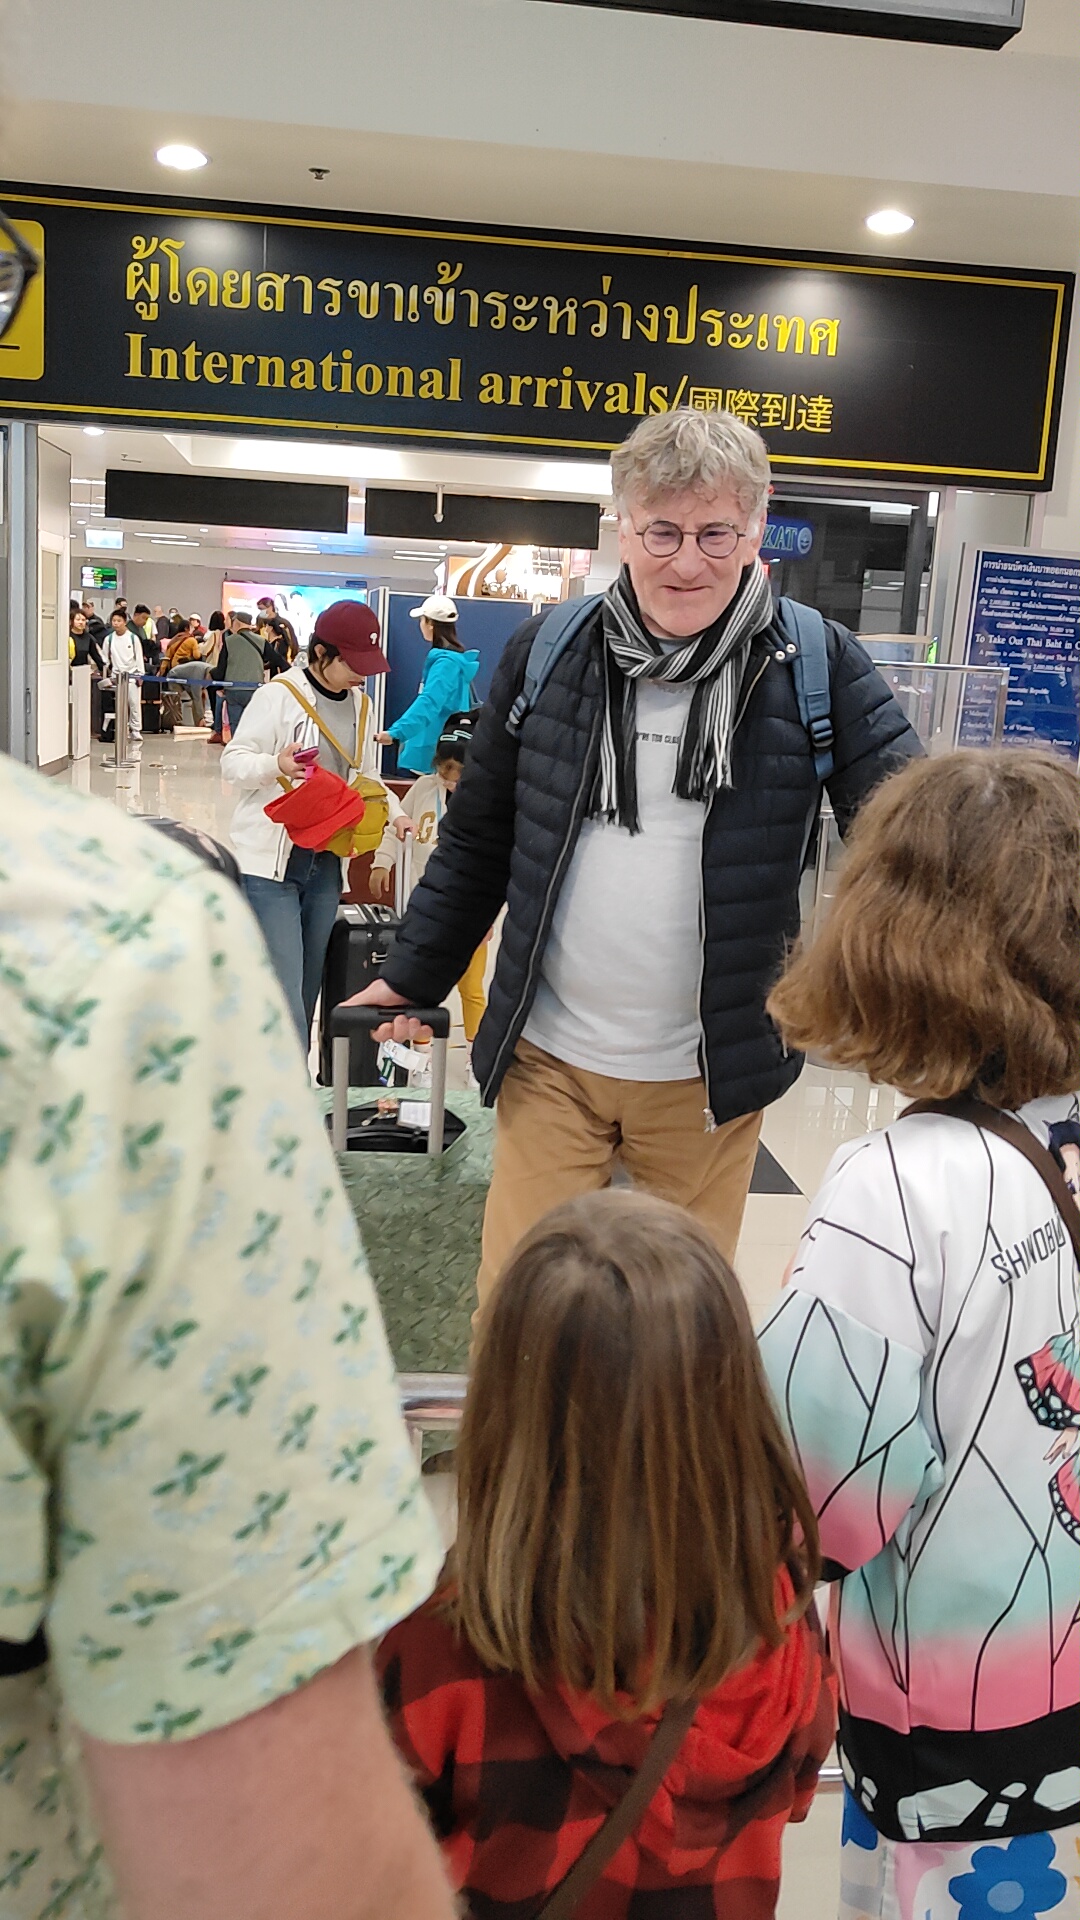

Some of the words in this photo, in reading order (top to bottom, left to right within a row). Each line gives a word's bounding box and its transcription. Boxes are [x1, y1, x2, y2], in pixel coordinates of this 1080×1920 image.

[127, 235, 841, 358] ผู้โดยสารขาเข้าระหว่างประเทศ
[124, 332, 463, 401] International
[975, 633, 986, 643] To
[988, 634, 1007, 645] Take
[1008, 636, 1024, 646] Out
[1026, 637, 1043, 647] Thai
[1045, 639, 1063, 648] Baht
[1064, 640, 1073, 649] in
[416, 811, 438, 845] G
